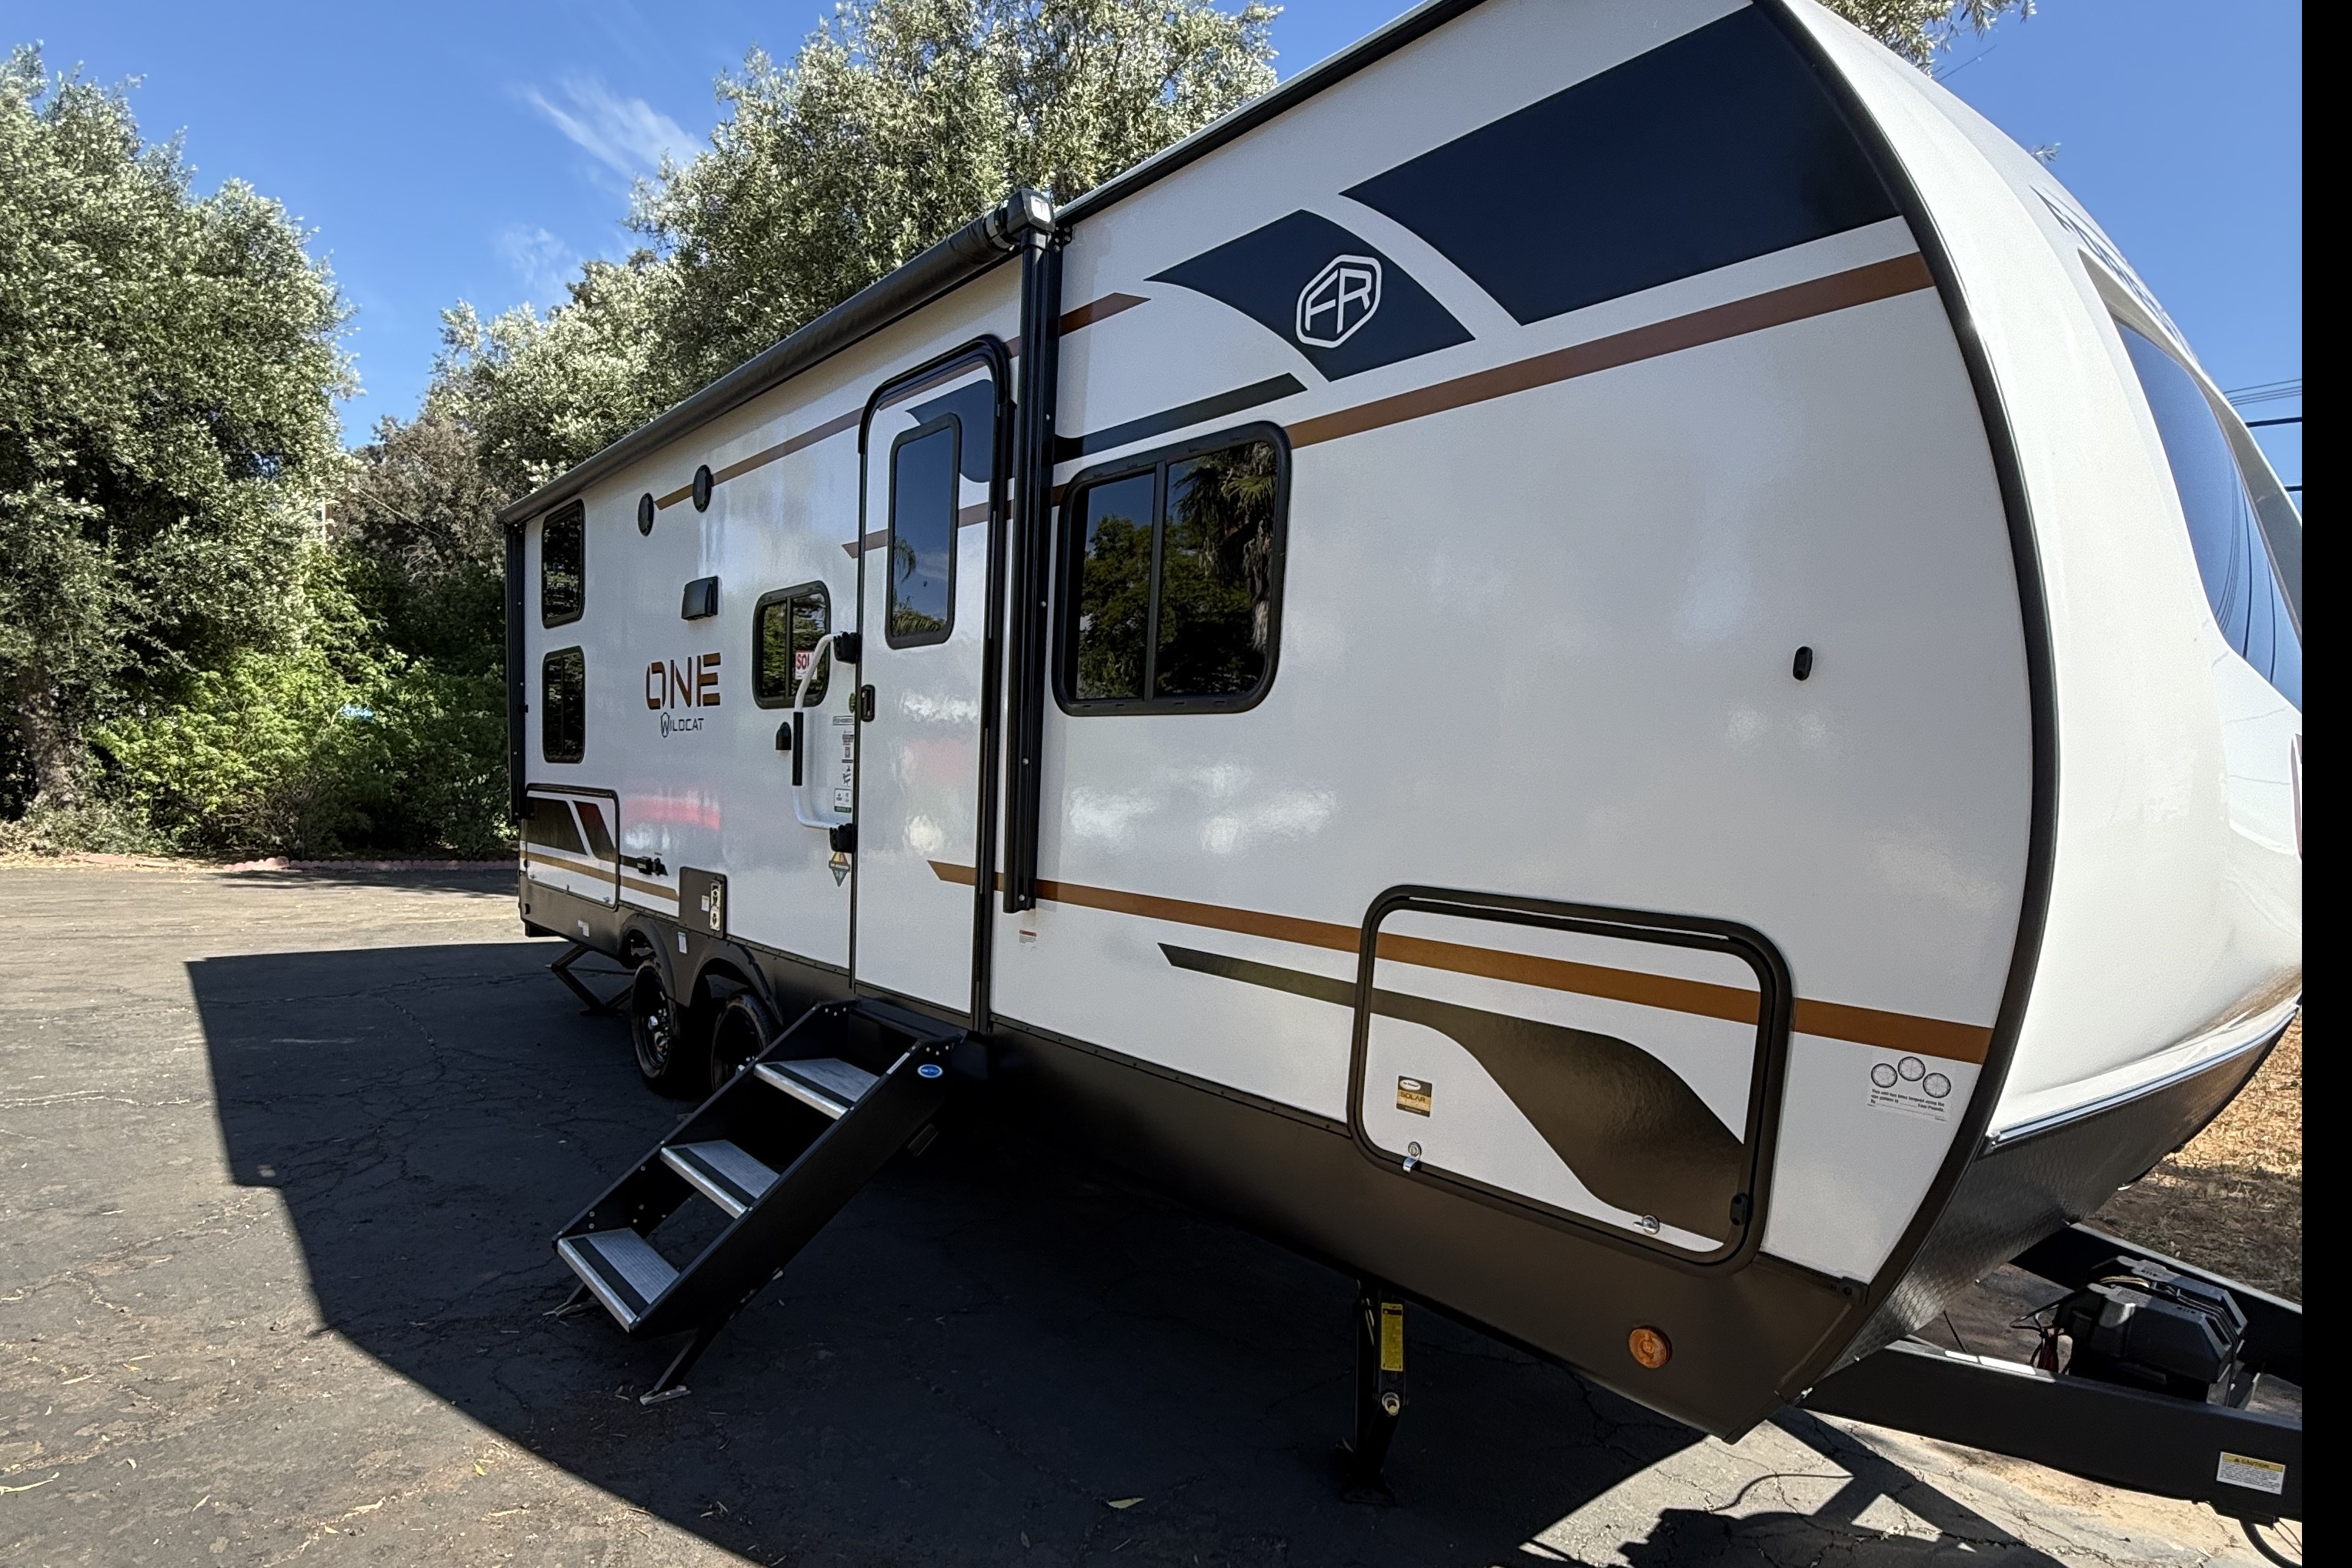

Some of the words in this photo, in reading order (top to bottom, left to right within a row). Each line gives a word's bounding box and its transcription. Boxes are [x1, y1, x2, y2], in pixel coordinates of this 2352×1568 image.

[646, 652, 722, 710] ONE
[660, 712, 705, 739] WILDCAT
[1400, 1092, 1426, 1103] SOLAR
